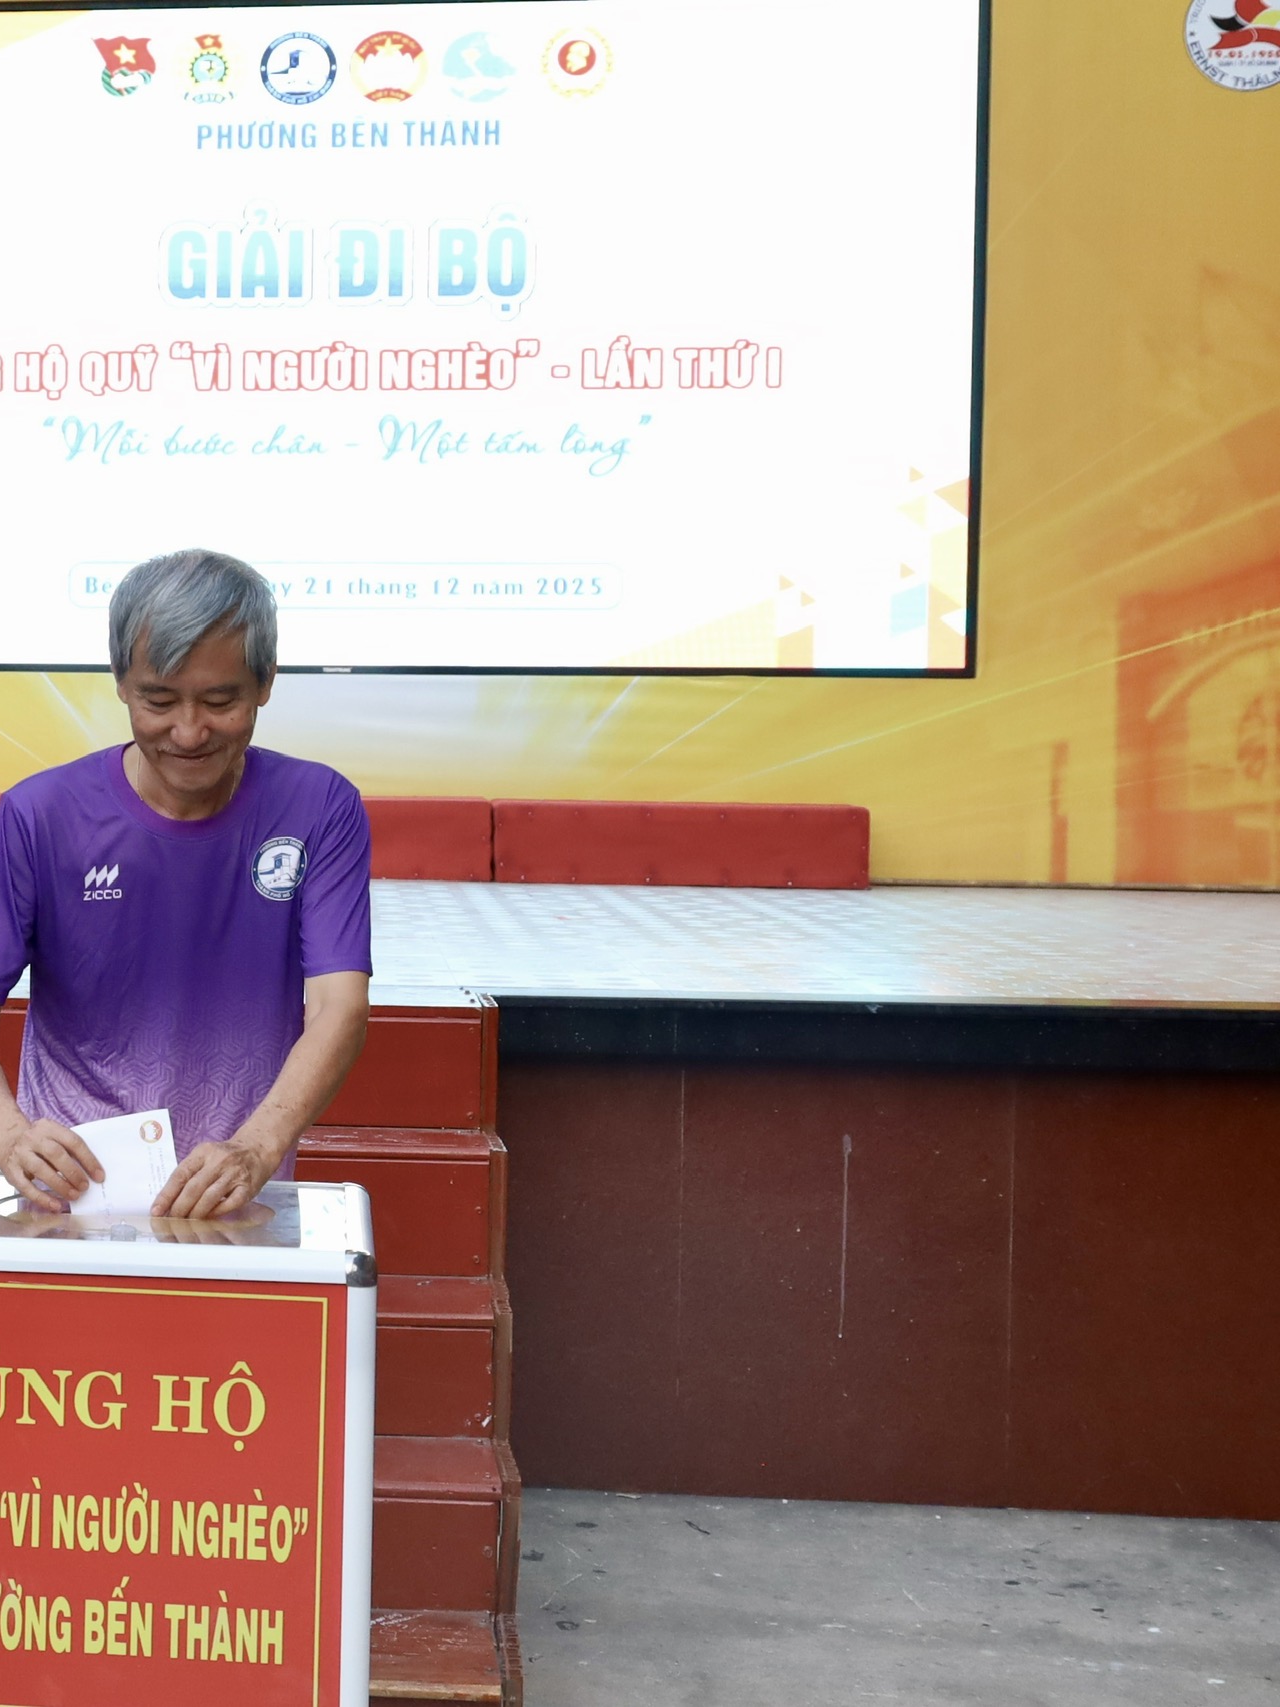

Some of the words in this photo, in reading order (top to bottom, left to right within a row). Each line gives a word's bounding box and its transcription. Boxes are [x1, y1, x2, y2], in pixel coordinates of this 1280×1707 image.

[1190, 40, 1229, 82] ERNST
[168, 207, 303, 299] GIẢI
[334, 230, 404, 298] ĐI
[438, 214, 526, 312] BỘ
[14, 344, 68, 401] HỘ
[79, 344, 159, 396] QUỸ
[242, 341, 368, 391] NGƯỜI
[673, 339, 759, 389] THỨ
[766, 346, 782, 388] I
[252, 425, 324, 454] chân
[305, 577, 331, 594] 21
[434, 578, 458, 595] 12
[537, 577, 602, 595] 2025
[83, 888, 122, 901] ZICCO
[152, 1362, 265, 1451] HỘ
[53, 1483, 159, 1554] NGƯỜI
[172, 1489, 308, 1562] NGHÈO”
[84, 1577, 152, 1656] BẾN
[165, 1591, 283, 1664] THÀNH
